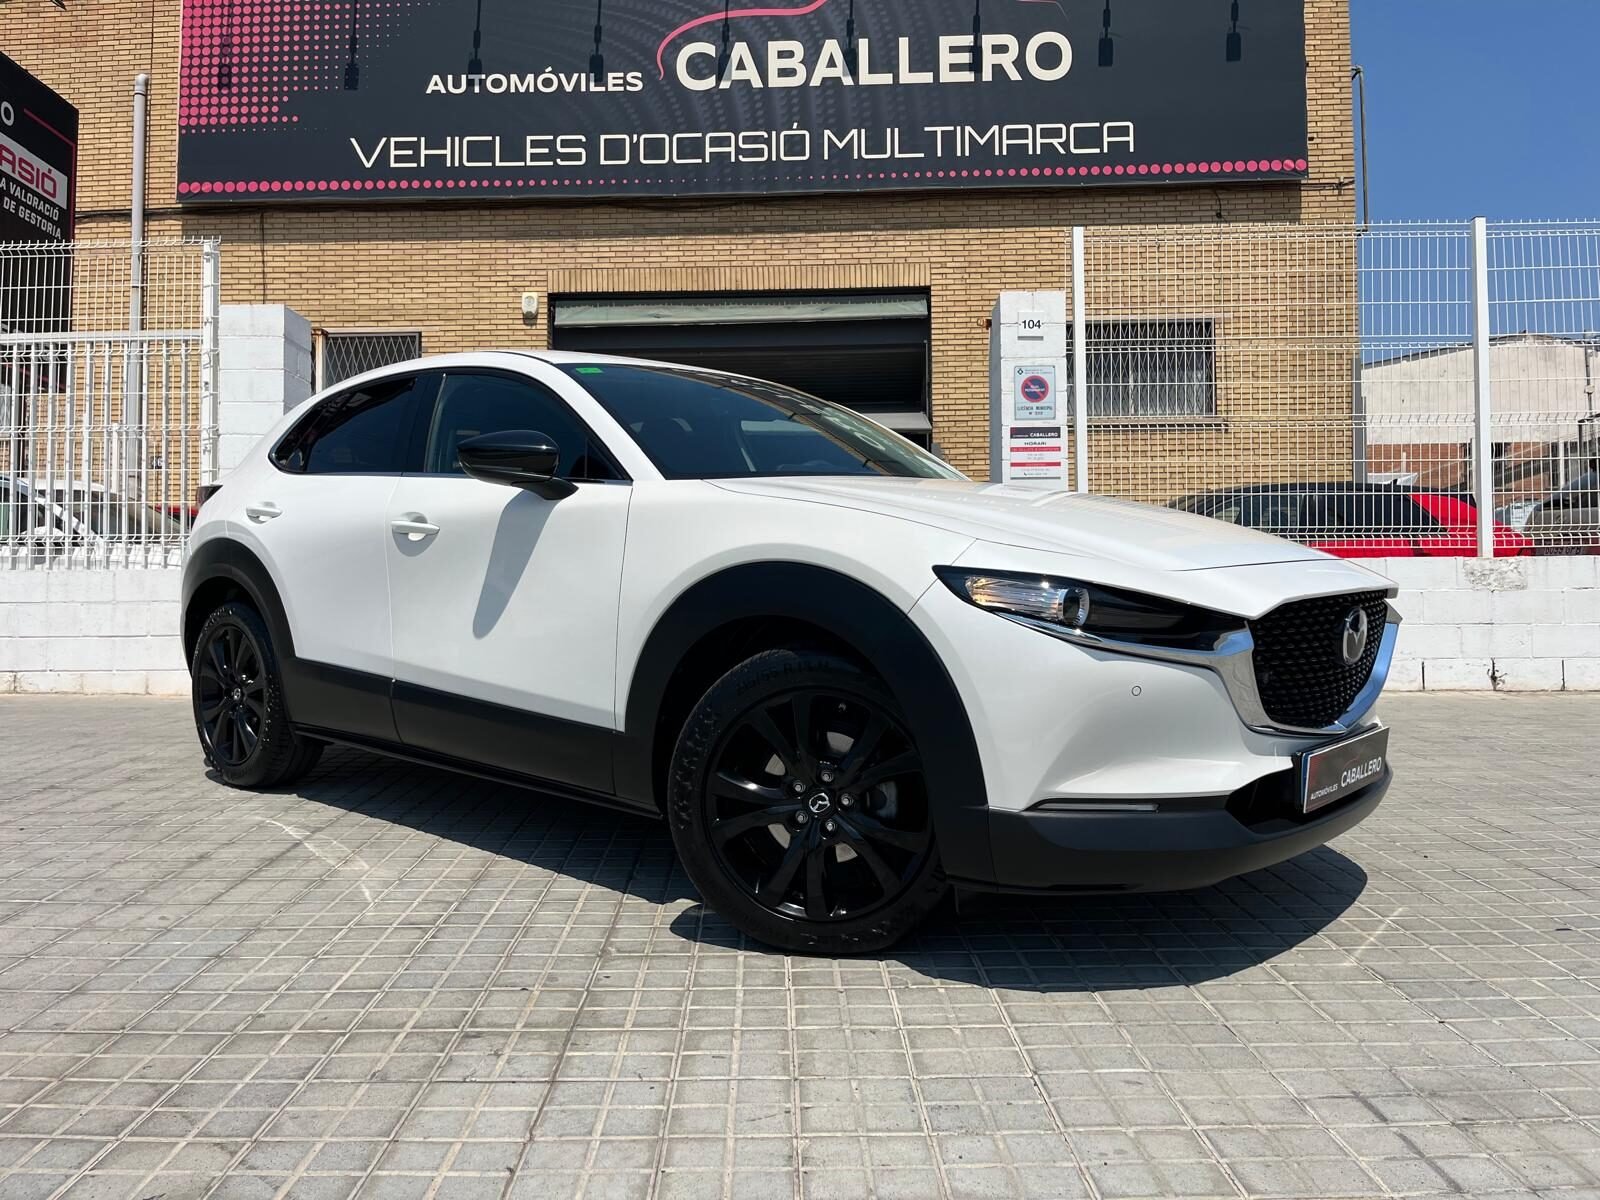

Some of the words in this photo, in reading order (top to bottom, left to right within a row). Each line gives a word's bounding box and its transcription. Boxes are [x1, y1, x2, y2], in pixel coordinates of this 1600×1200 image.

[425, 66, 644, 95] AUTOMÓVILES
[676, 31, 1073, 91] CABALLERO
[349, 134, 587, 169] VEHICLES
[599, 122, 810, 165] D'OCASIÓ
[823, 121, 1134, 160] MULTIMARCA
[3, 196, 16, 214] DE
[18, 205, 61, 240] GESTORIA
[9, 182, 59, 221] VALORACIÓ
[1022, 319, 1041, 329] 104
[1341, 756, 1382, 787] CABALLERO
